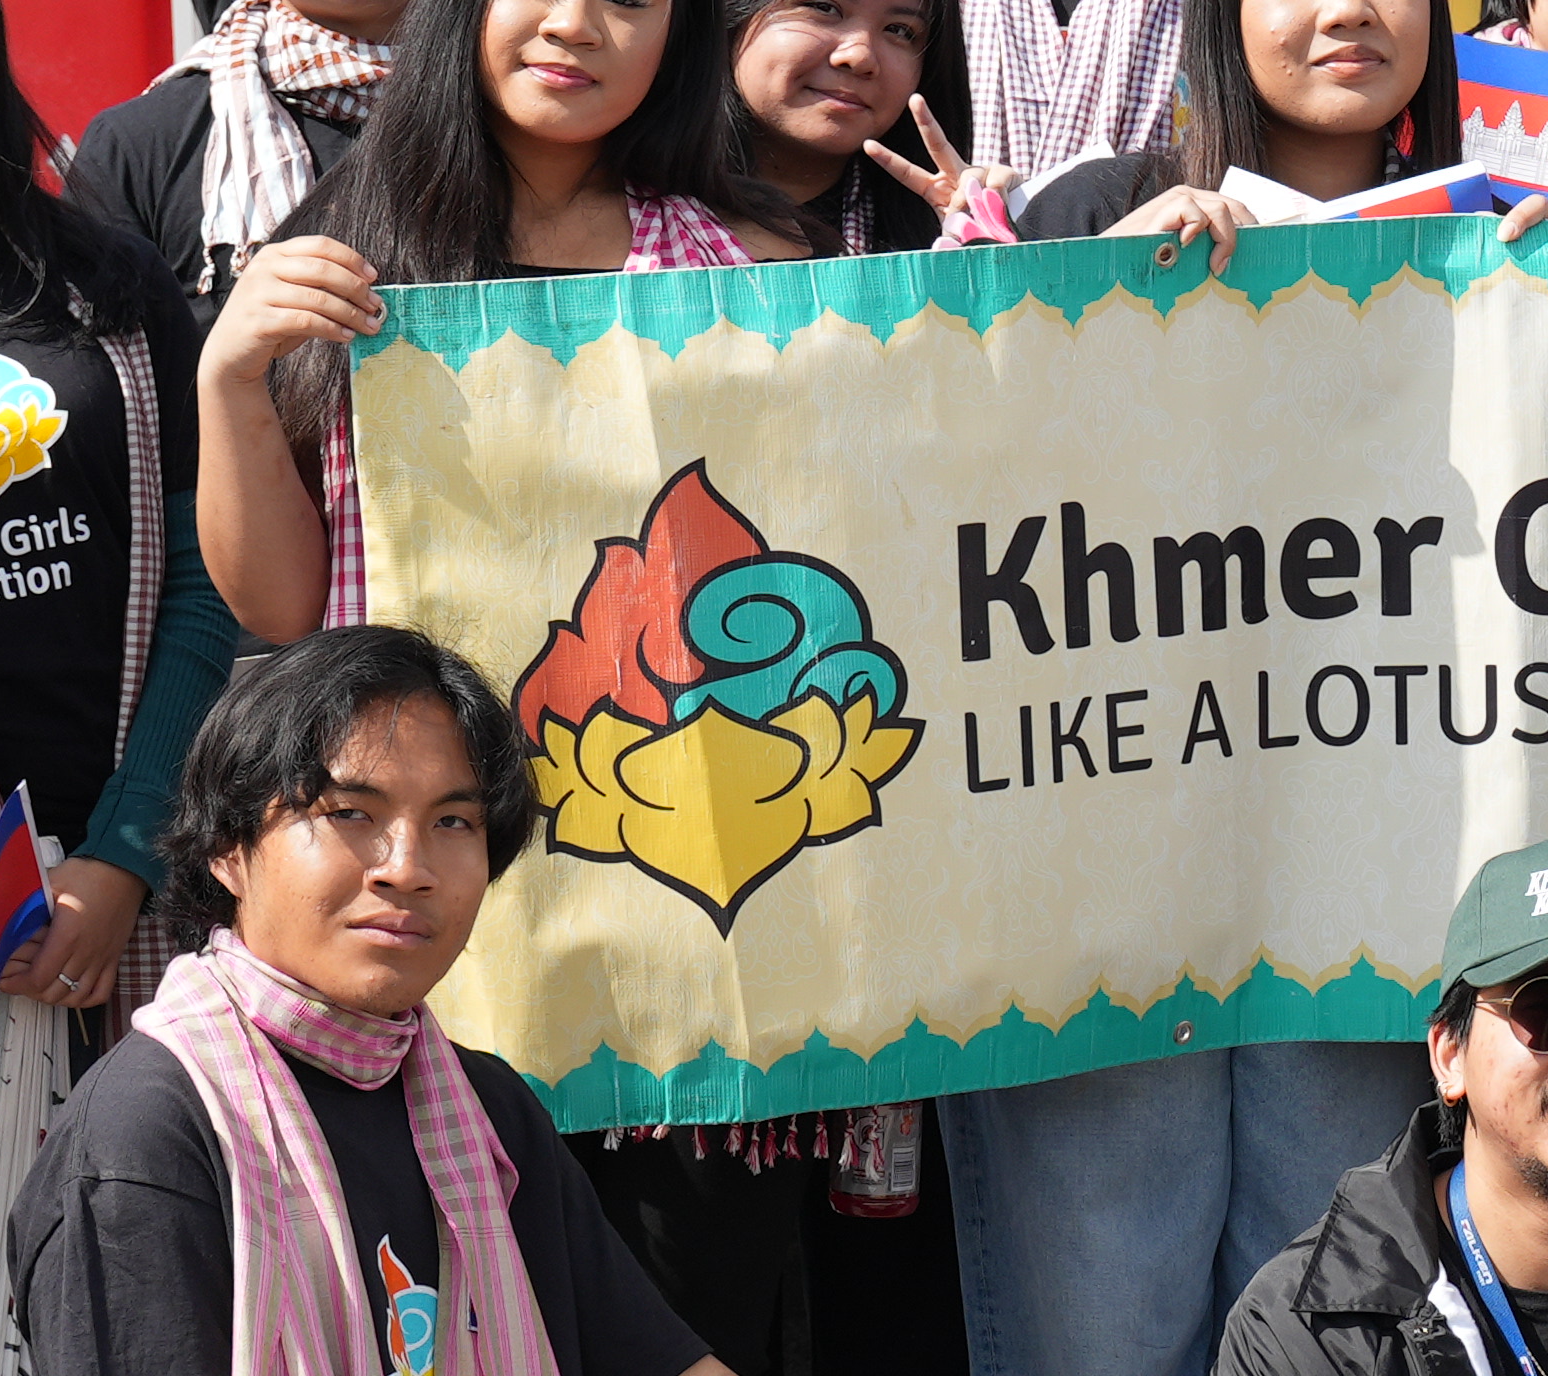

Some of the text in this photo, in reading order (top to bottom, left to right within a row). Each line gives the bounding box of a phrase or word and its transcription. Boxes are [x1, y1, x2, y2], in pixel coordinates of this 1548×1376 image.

[0, 507, 92, 557] Girls
[957, 501, 1444, 662] Khmer
[964, 689, 1153, 794] LIKE
[1181, 680, 1233, 765] A
